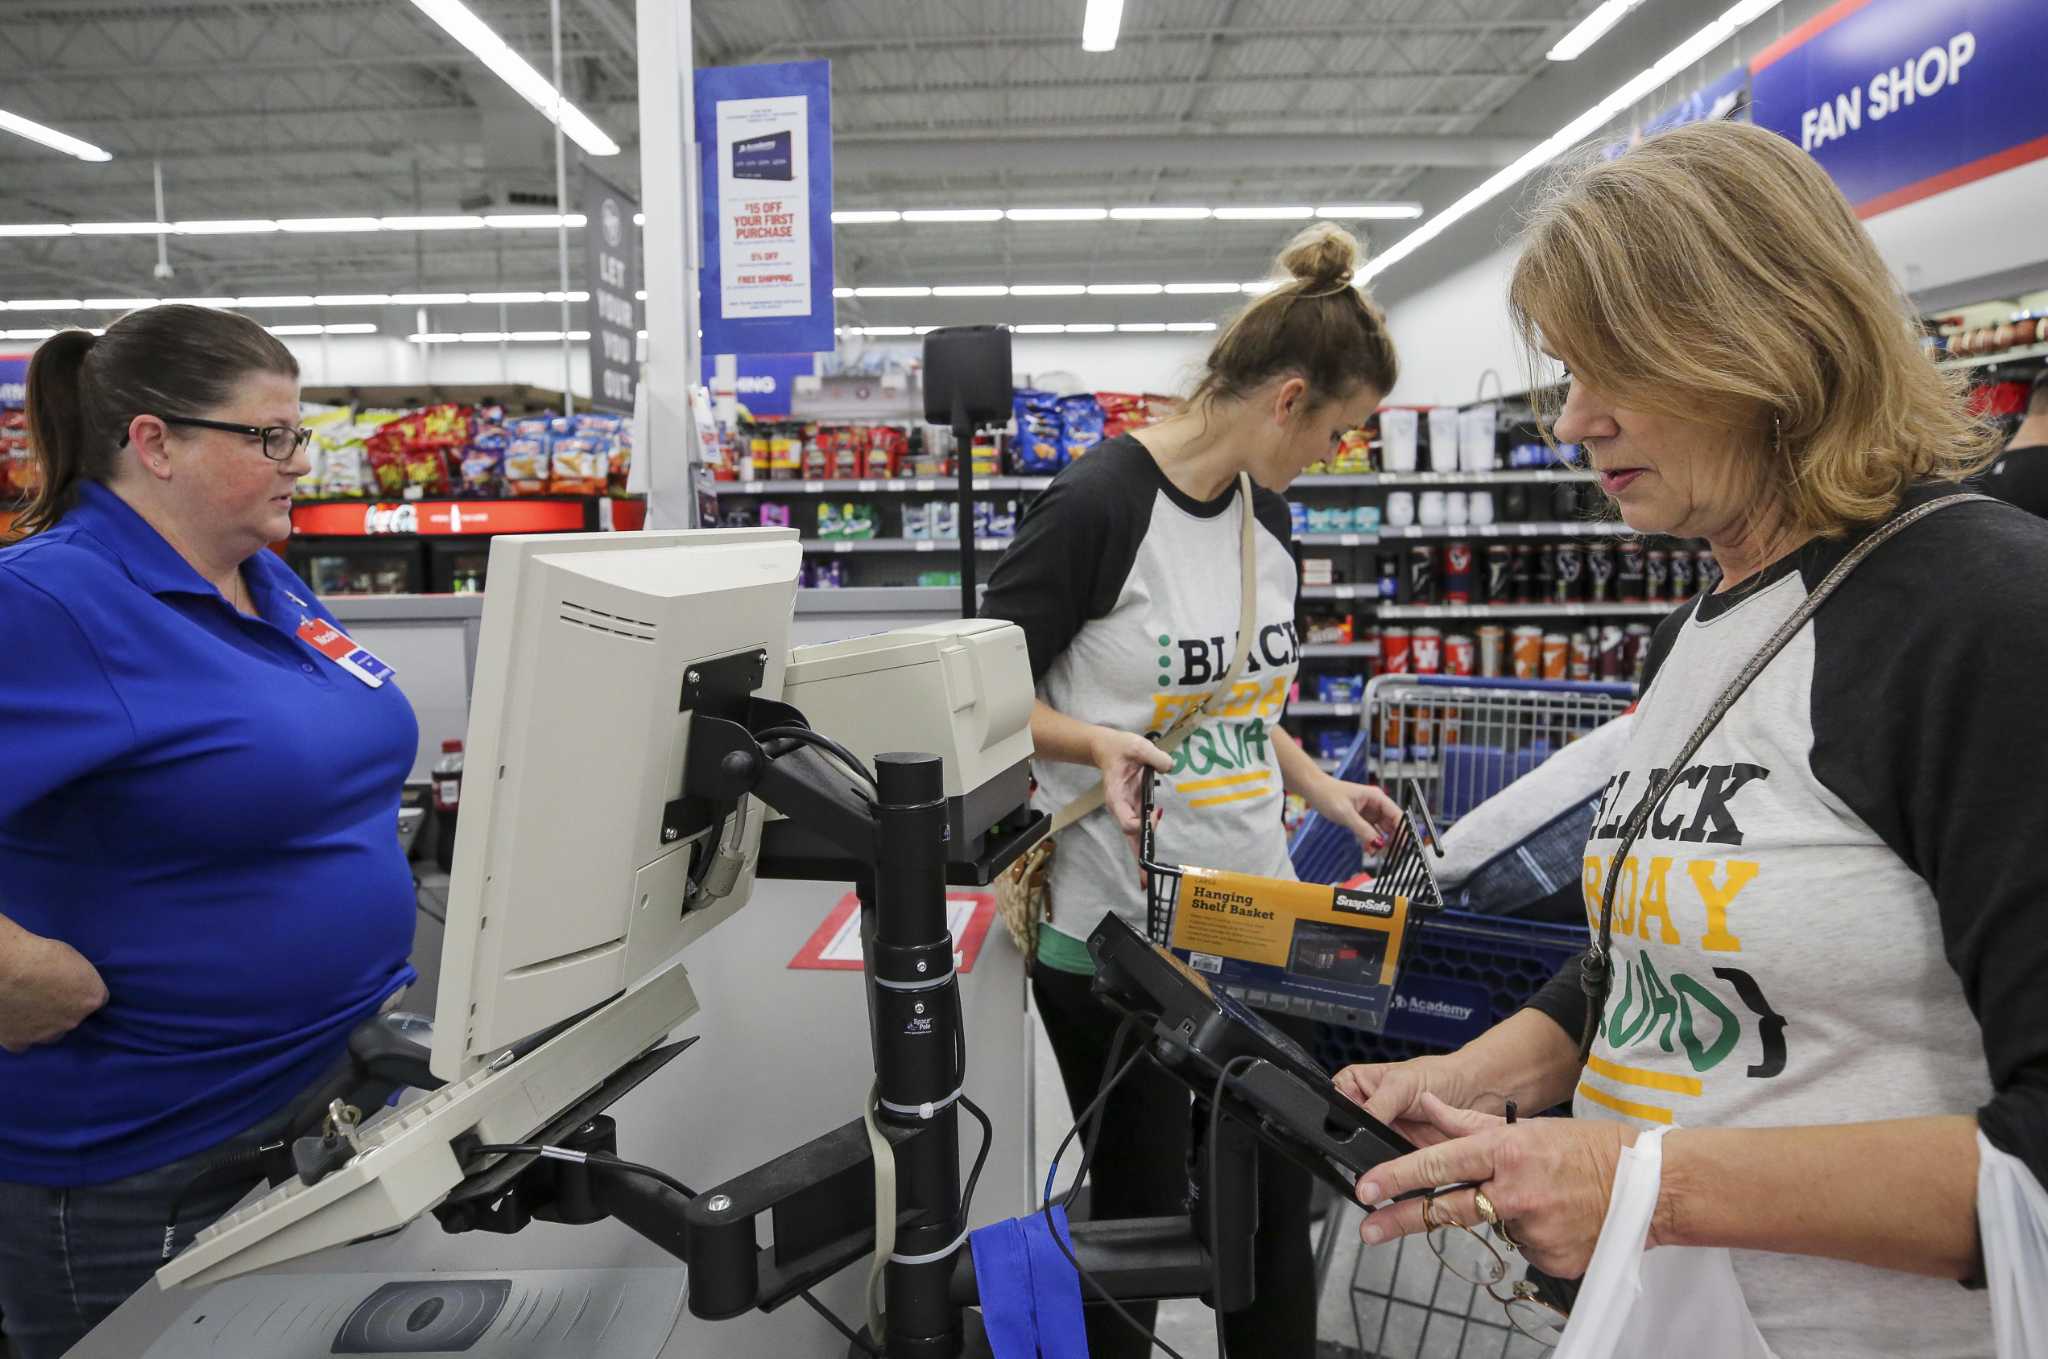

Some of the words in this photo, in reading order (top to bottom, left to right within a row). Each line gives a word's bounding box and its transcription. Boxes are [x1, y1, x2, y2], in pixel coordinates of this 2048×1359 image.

[1801, 86, 1862, 152] FAN
[1867, 31, 1976, 121] SHOP
[762, 201, 783, 213] OFF
[734, 215, 762, 227] YOUR
[764, 213, 795, 226] FIRST
[735, 226, 793, 239] PURCHASE
[764, 251, 779, 261] OFF
[600, 252, 626, 289] LET
[596, 288, 634, 330] YOUR
[602, 329, 632, 366] YOU
[1193, 886, 1253, 906] Hanging
[1335, 894, 1392, 913] SnapSafe
[1191, 898, 1227, 913] Shelf
[1229, 904, 1275, 920] Basket
[1408, 996, 1474, 1020] Academy
